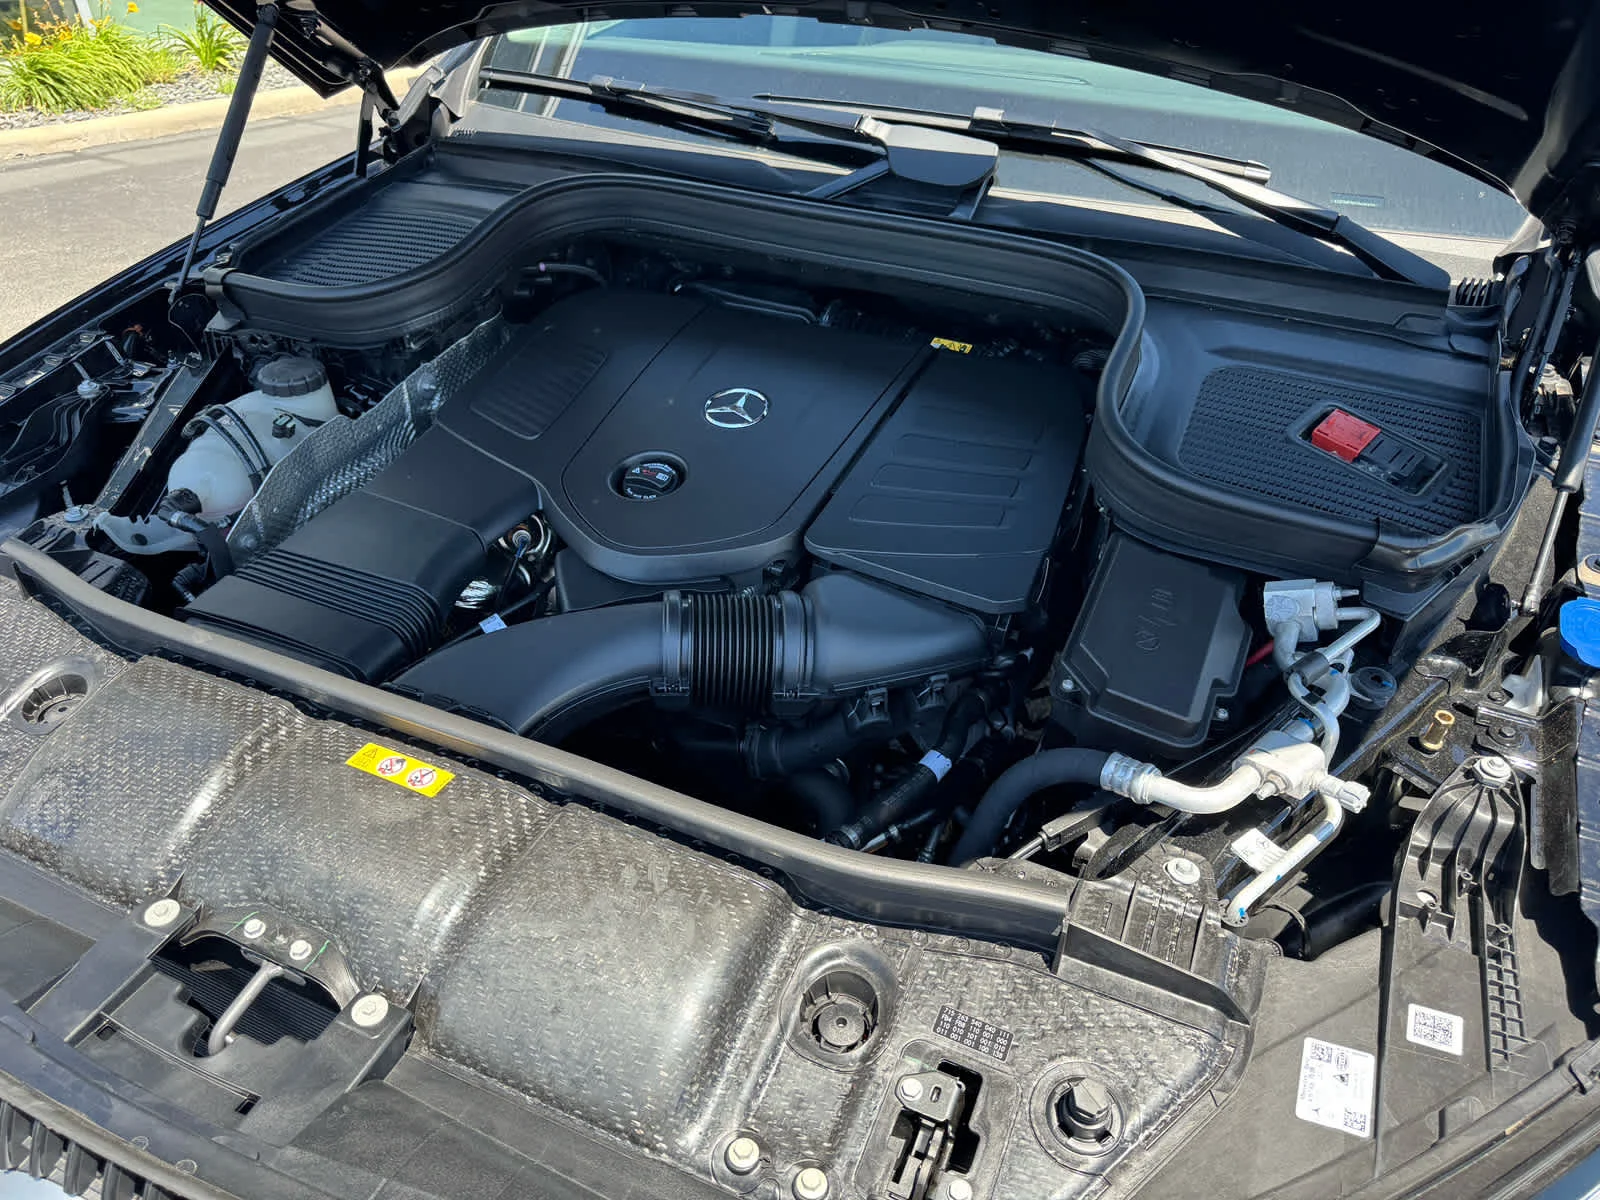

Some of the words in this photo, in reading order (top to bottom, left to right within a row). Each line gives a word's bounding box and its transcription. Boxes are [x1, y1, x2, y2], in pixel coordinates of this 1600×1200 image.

[936, 1027, 948, 1035] 011
[950, 1032, 962, 1041] 001
[964, 1038, 975, 1047] 001
[940, 1020, 950, 1029] 110
[952, 1026, 964, 1034] 010
[967, 1032, 978, 1040] 101
[980, 1038, 991, 1046] 001
[994, 1043, 1006, 1052] 010
[970, 1026, 980, 1034] 110
[982, 1032, 994, 1040] 001
